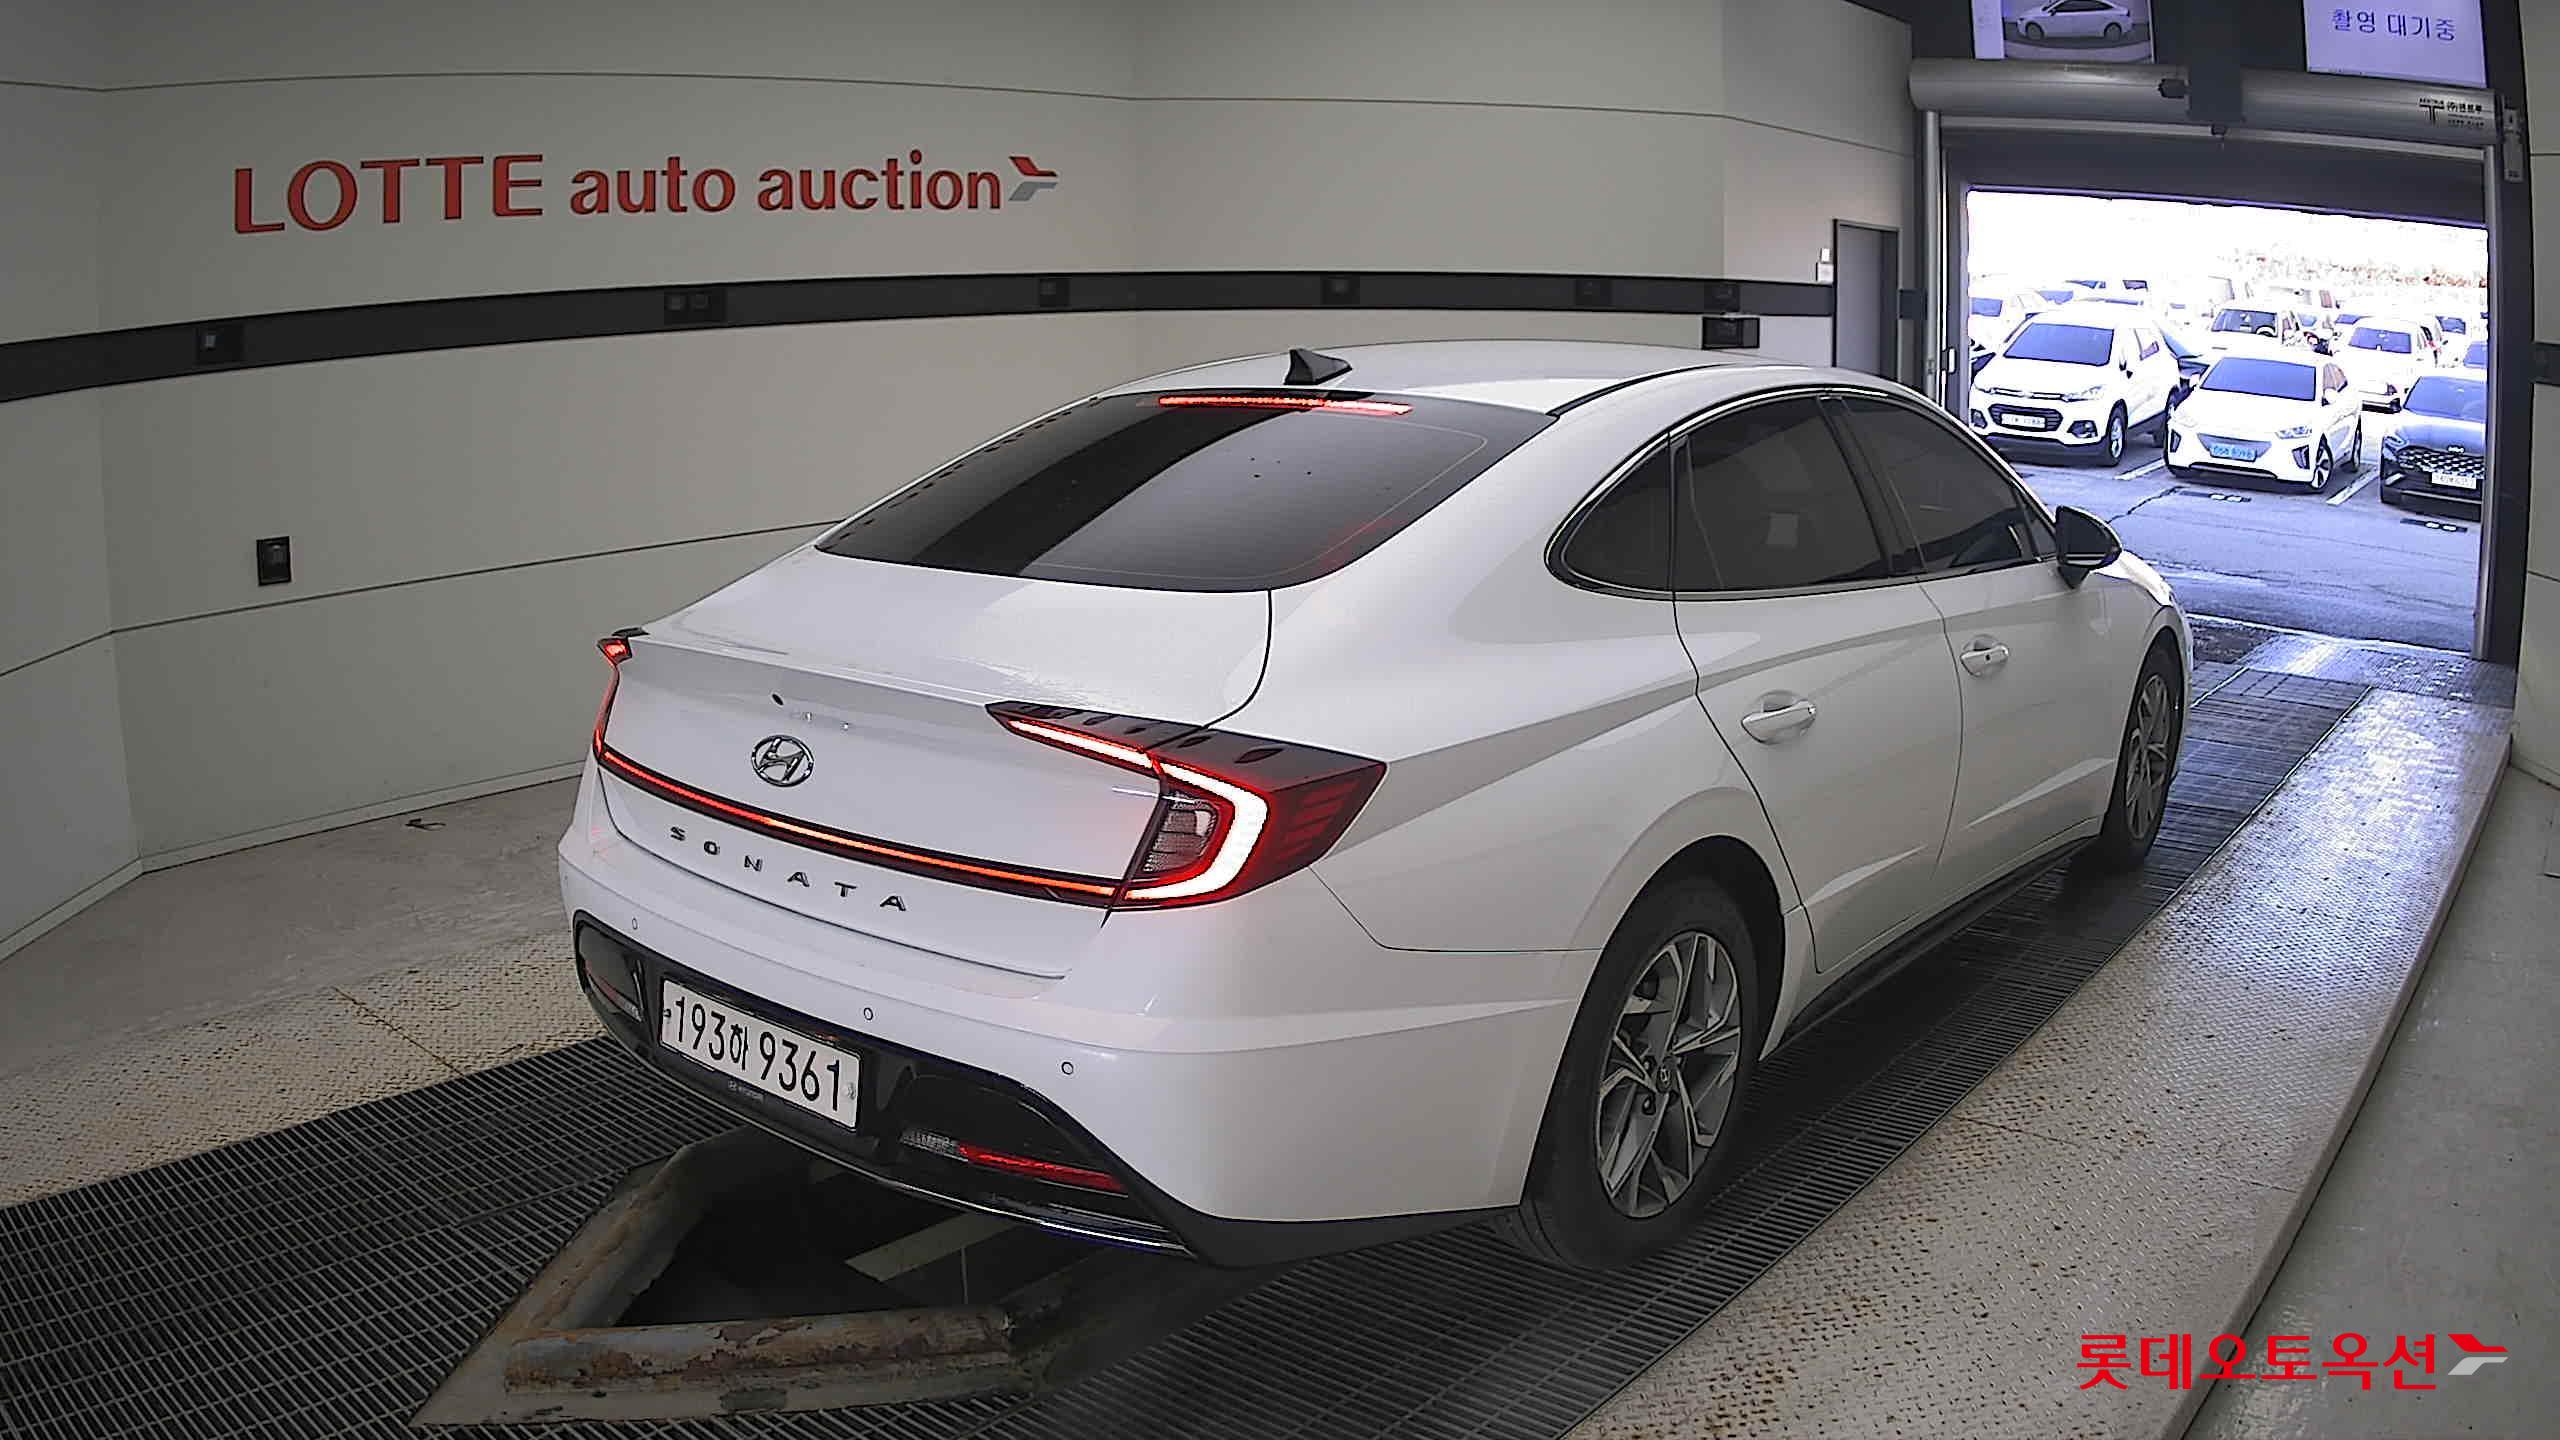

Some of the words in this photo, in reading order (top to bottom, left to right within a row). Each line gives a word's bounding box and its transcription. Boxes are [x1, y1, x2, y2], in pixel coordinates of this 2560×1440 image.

[2331, 7, 2376, 34] 촬영
[2387, 13, 2456, 42] 대기중
[234, 154, 543, 234] LOTTE
[568, 156, 737, 215] auto
[757, 149, 1001, 211] auction
[670, 826, 907, 912] SONATA
[675, 996, 749, 1071] 193하
[759, 1031, 840, 1112] 9361
